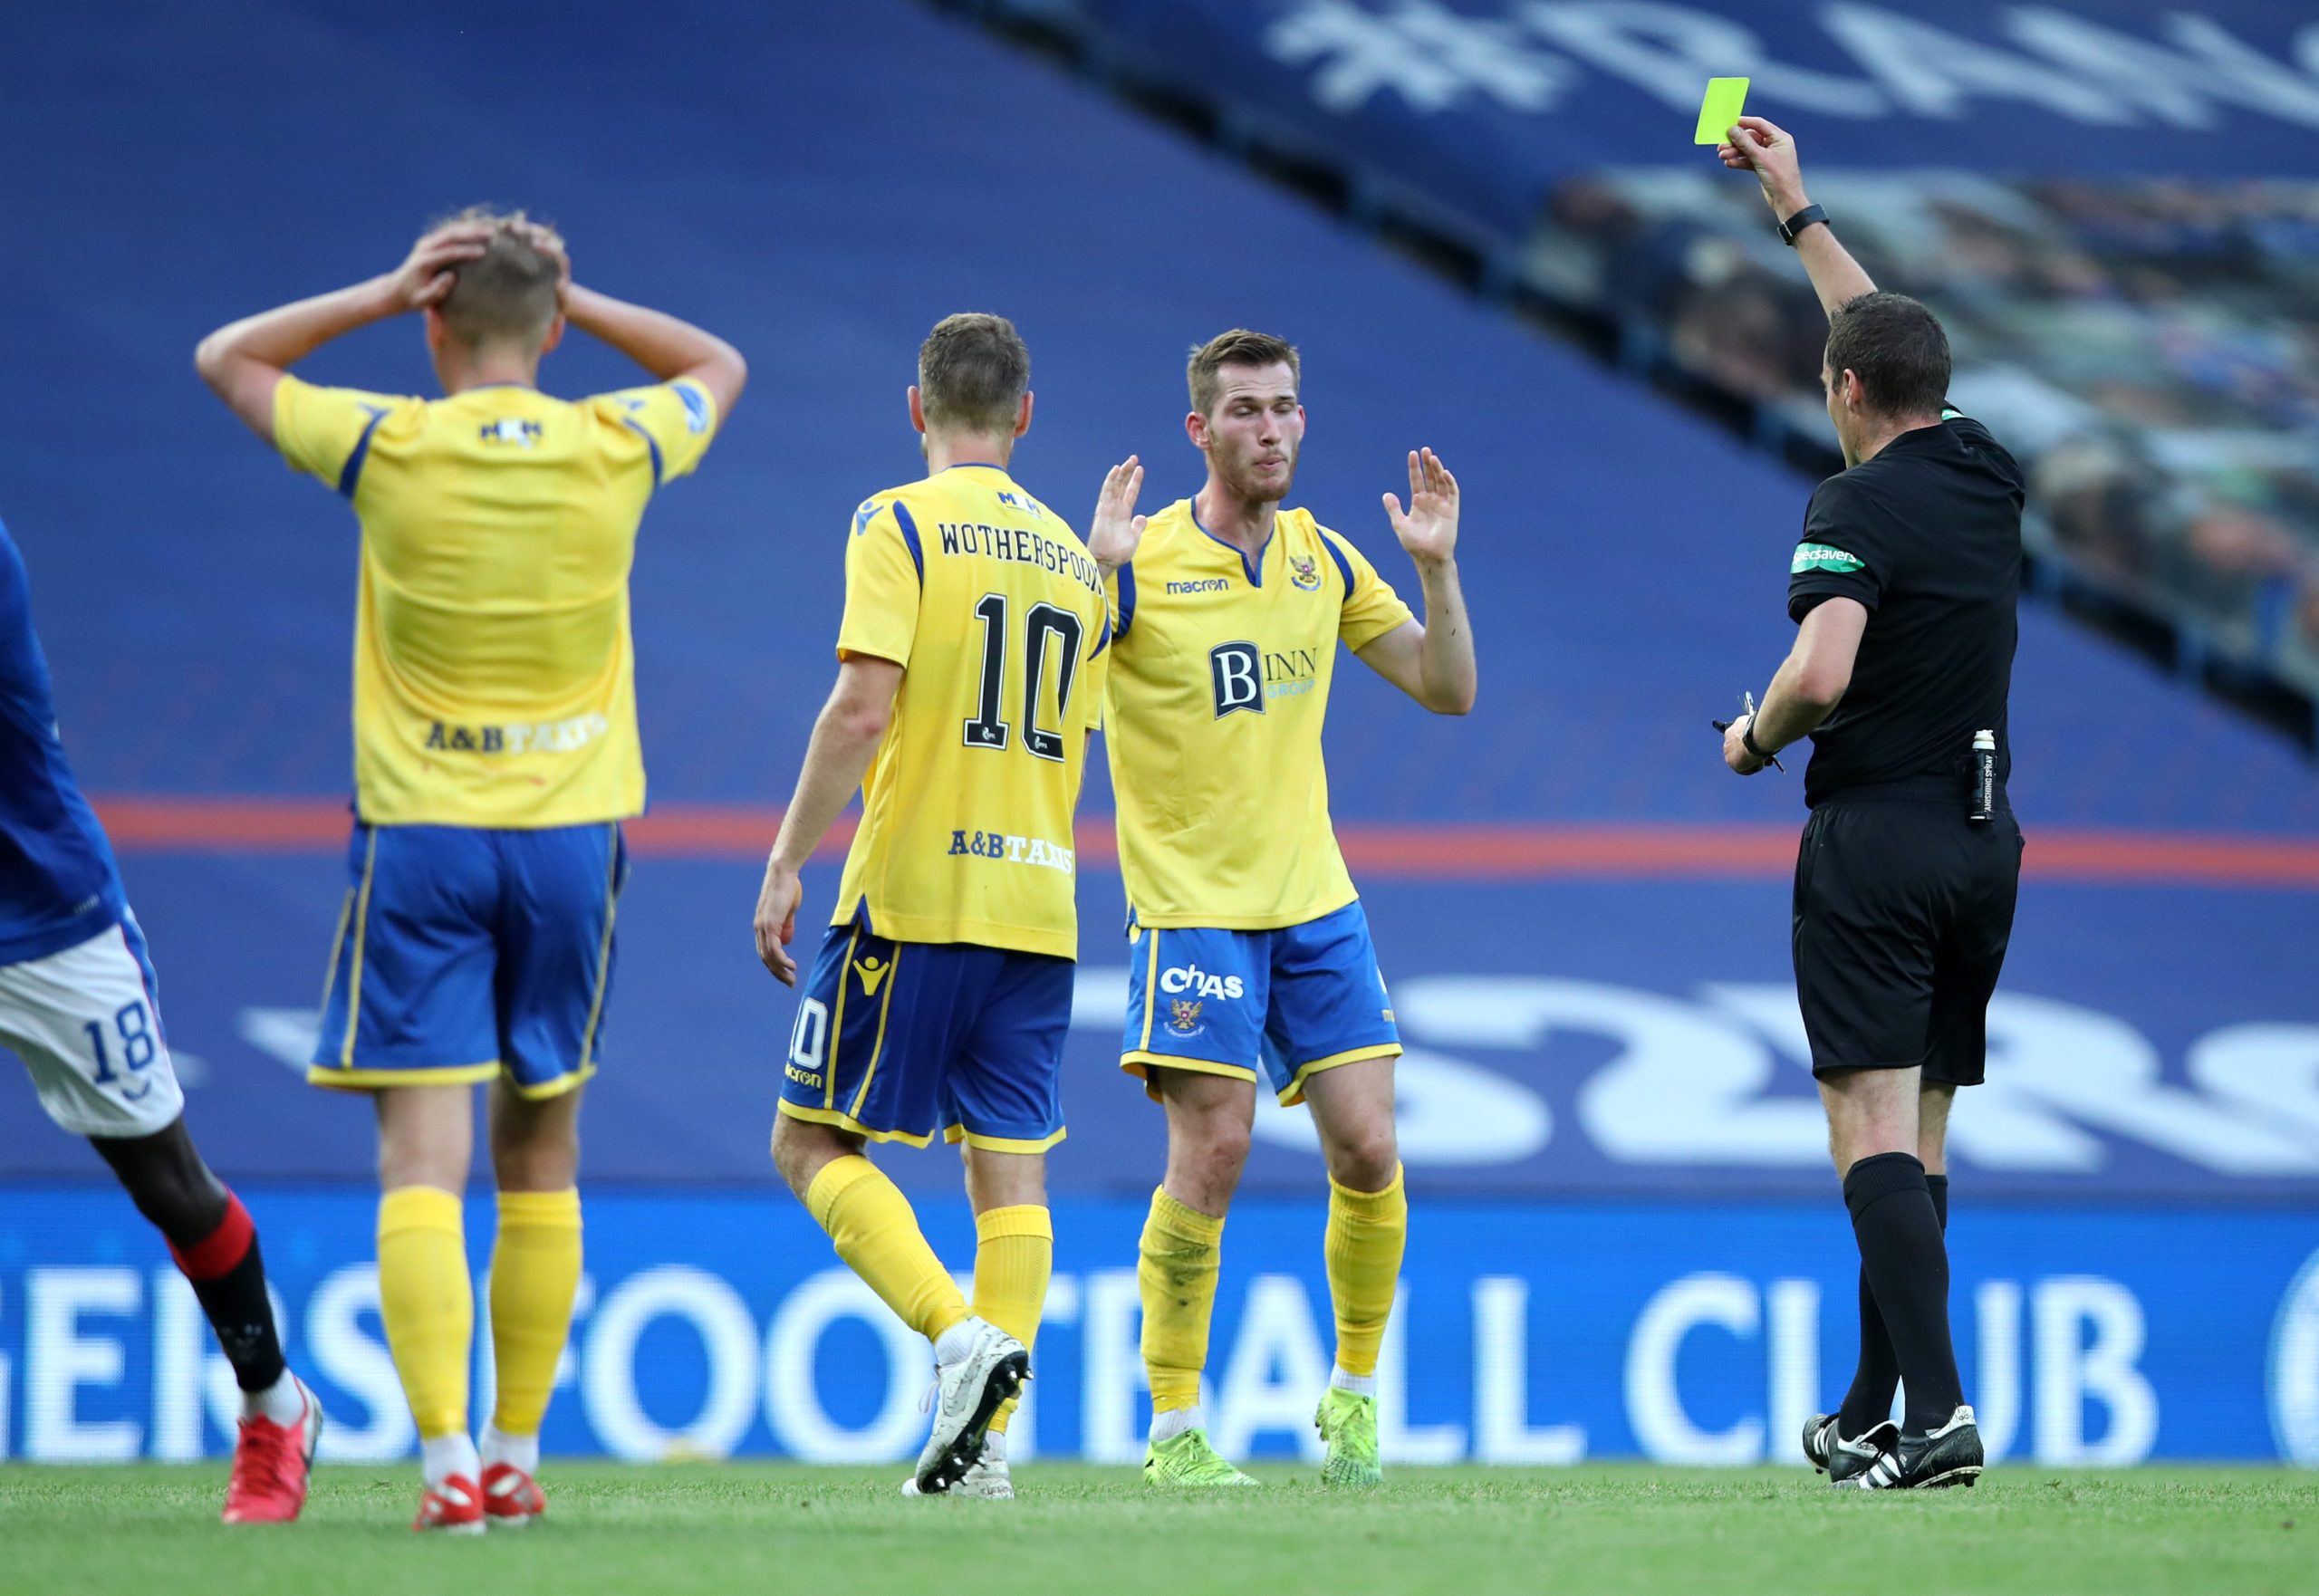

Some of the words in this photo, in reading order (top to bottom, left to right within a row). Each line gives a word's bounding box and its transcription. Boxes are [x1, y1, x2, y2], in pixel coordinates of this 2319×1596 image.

[1264, 0, 2319, 130] #RAN
[938, 522, 1102, 596] WOTHERSPOON
[1167, 577, 1228, 595] macron
[963, 591, 1084, 763] 10
[1266, 678, 1315, 698] GROUP
[1984, 778, 1993, 812] ANISHING
[1985, 755, 1994, 777] SPRAY
[83, 1000, 155, 1084] 18
[789, 996, 828, 1070] 0
[785, 1061, 822, 1088] cron
[0, 1262, 419, 1464] ERS
